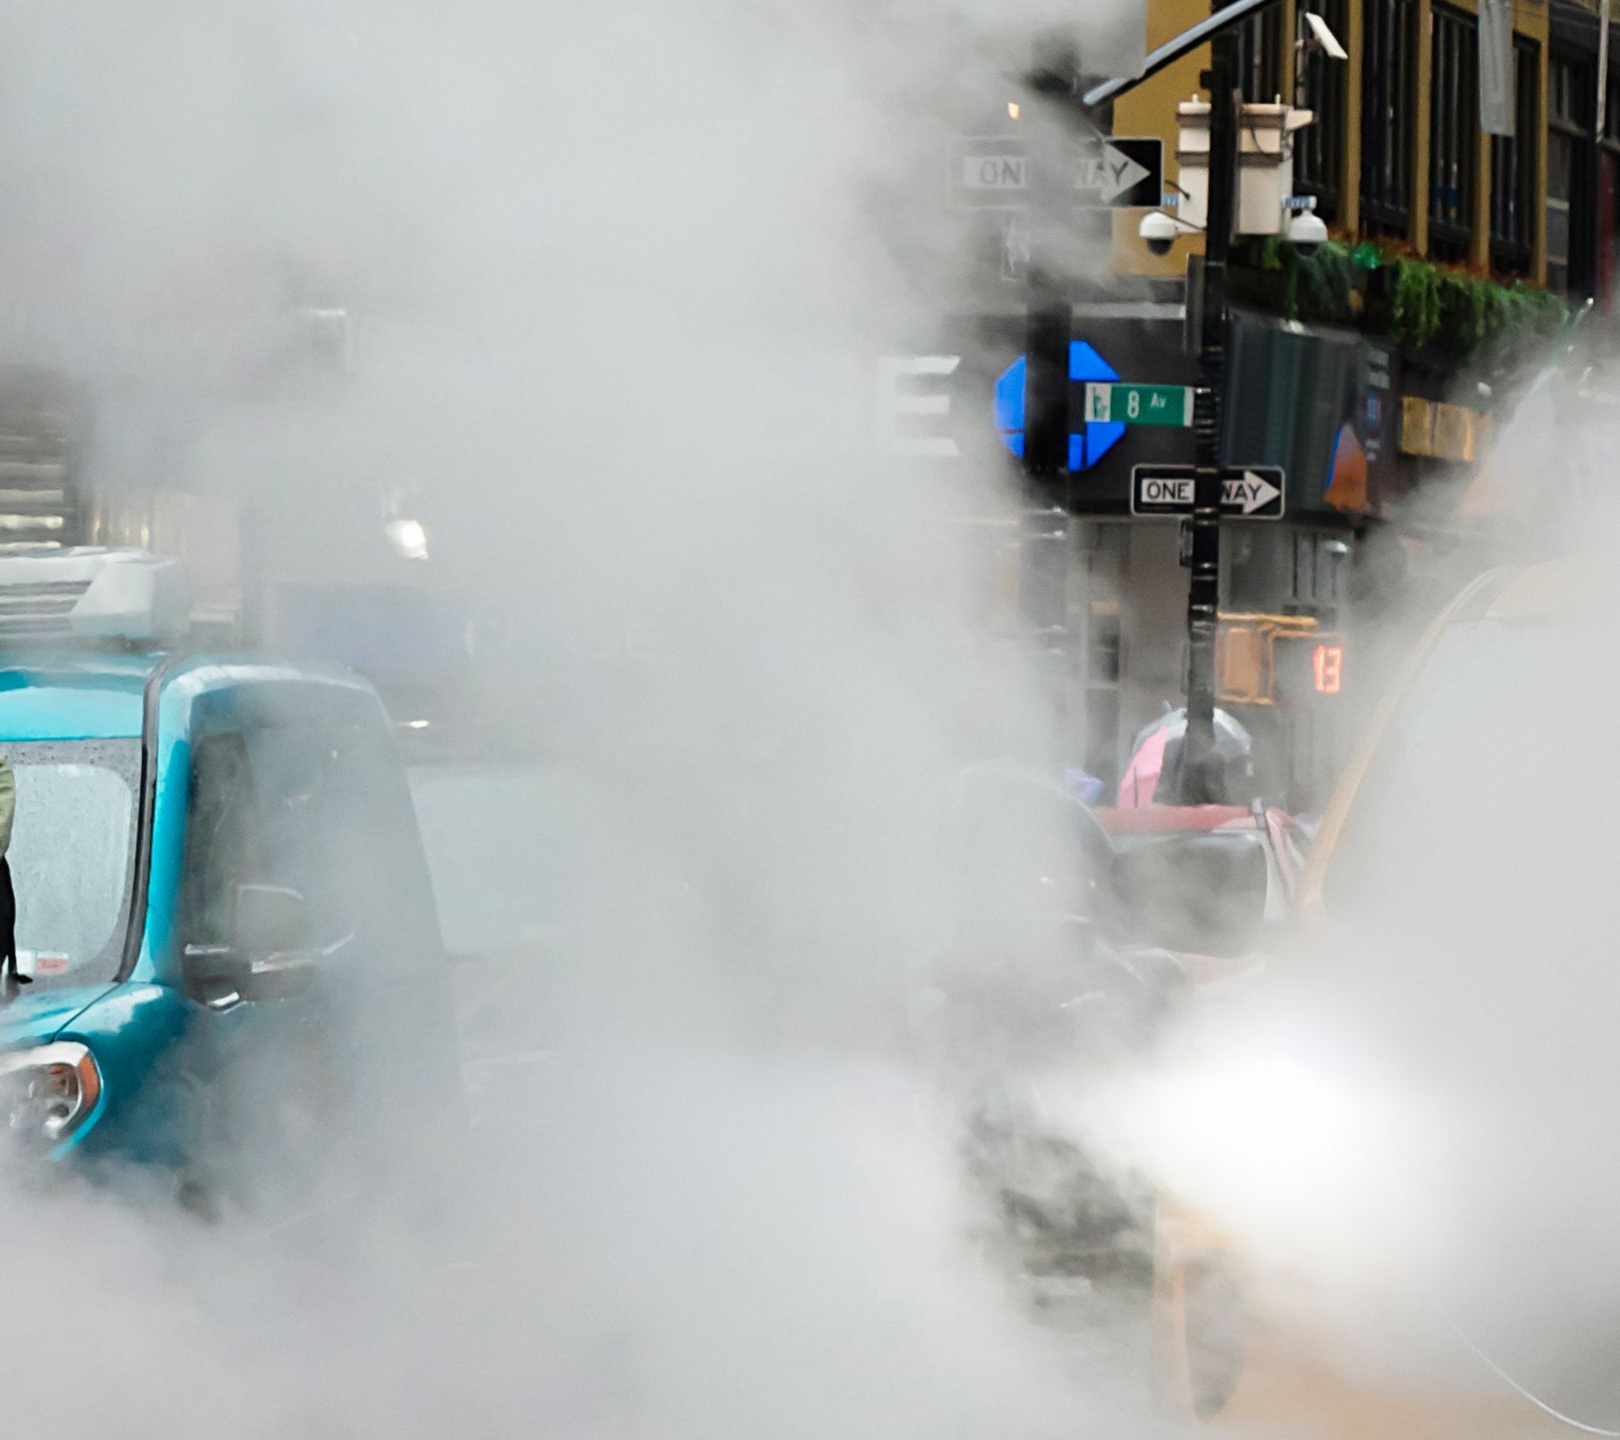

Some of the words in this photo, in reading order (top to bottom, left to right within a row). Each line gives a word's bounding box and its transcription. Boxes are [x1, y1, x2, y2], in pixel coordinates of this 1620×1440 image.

[980, 161, 1025, 185] ON
[1127, 390, 1140, 418] 8
[1150, 392, 1166, 408] Av
[1146, 480, 1190, 500] ONE
[1313, 644, 1342, 694] 13
